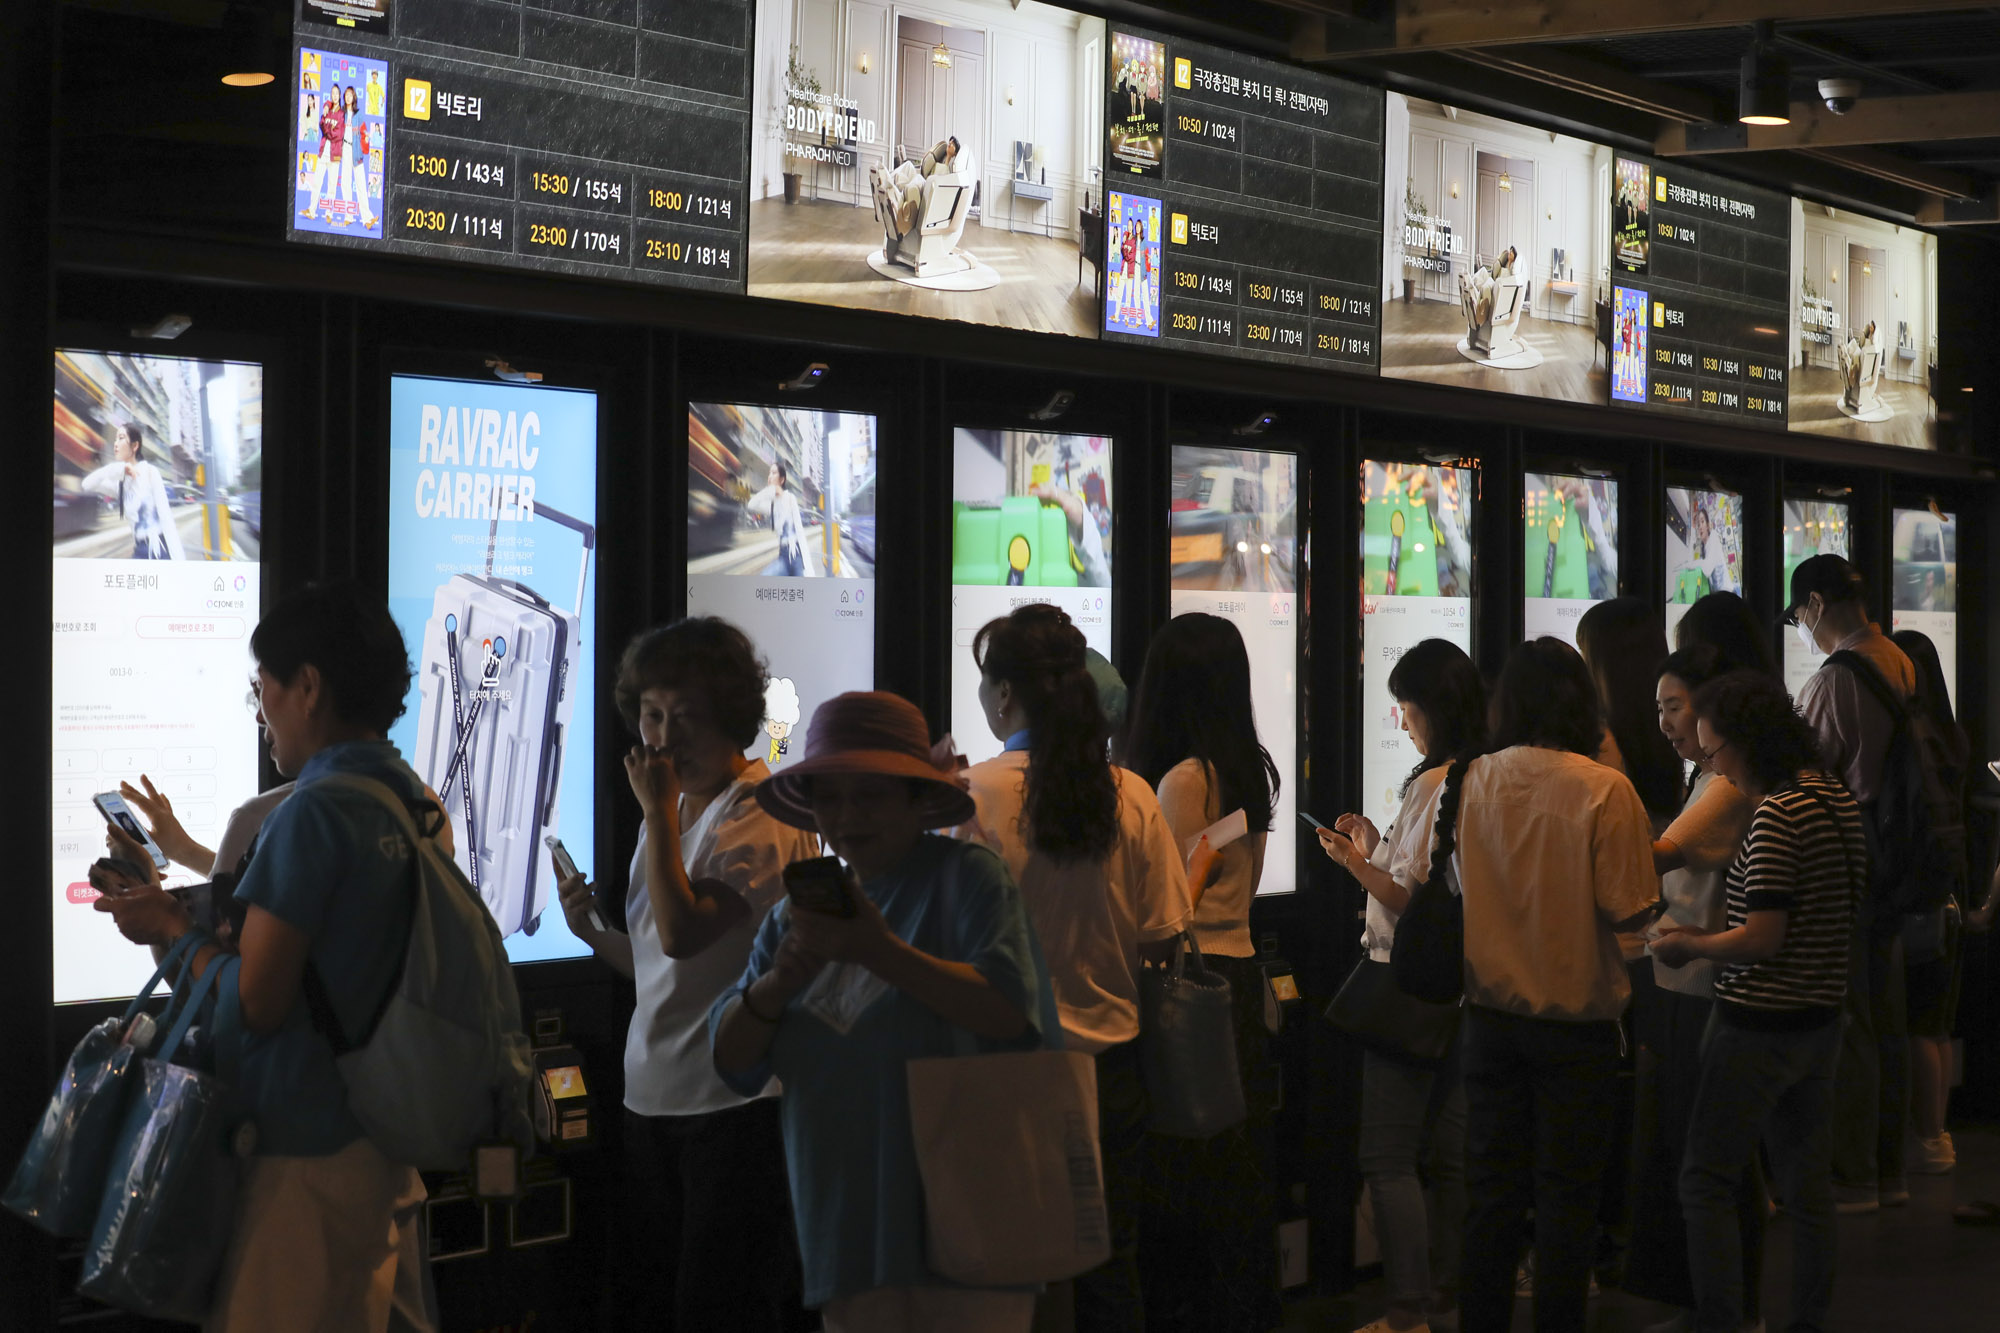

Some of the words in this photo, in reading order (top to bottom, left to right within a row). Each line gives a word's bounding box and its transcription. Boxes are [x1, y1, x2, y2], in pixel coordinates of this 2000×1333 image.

[787, 85, 832, 105] Healthcare
[833, 93, 858, 110] Robot
[1177, 65, 1188, 83] 12
[1194, 67, 1240, 96] 극장총집편
[1242, 79, 1260, 100] 봇치
[1263, 84, 1272, 103] 더
[1274, 87, 1287, 106] 록!
[1289, 91, 1329, 116] 전편(자막)
[409, 87, 426, 113] 12
[437, 91, 482, 121] 빅토리
[786, 104, 875, 144] BODYFRIEND
[1177, 115, 1201, 134] 10:50
[1203, 120, 1208, 137] /
[1211, 123, 1236, 143] 102석
[786, 143, 830, 163] PHARAOH
[832, 151, 851, 166] NEO
[409, 154, 447, 177] 13:00
[452, 159, 459, 180] /
[465, 162, 504, 187] 143석
[533, 172, 568, 194] 15:30
[572, 177, 580, 197] /
[585, 180, 622, 203] 155석
[1658, 181, 1665, 197] 12
[1668, 183, 1698, 206] 극장총집편
[1699, 191, 1711, 209] 봇치
[1712, 195, 1719, 211] 더
[319, 198, 360, 216] 빅토리
[648, 189, 682, 211] 18:00
[685, 194, 692, 213] /
[697, 197, 731, 219] 121석
[406, 208, 445, 231] 20:30
[450, 213, 458, 233] /
[463, 215, 502, 240] 111석
[1405, 209, 1434, 225] Healthcare
[1435, 215, 1451, 228] Robot
[530, 224, 567, 246] 23:00
[571, 229, 578, 249] /
[584, 231, 620, 254] 170석
[1174, 220, 1185, 239] 12
[1191, 223, 1219, 245] 빅토리
[1405, 225, 1463, 255] BODYFRIEND
[1657, 223, 1673, 238] 10:50
[1674, 227, 1678, 240] /
[1679, 228, 1695, 244] 102석
[646, 239, 681, 261] 25:10
[684, 244, 691, 263] /
[696, 247, 730, 269] 181석
[1404, 255, 1433, 270] PHARAOH
[1434, 261, 1447, 273] NEO
[1174, 271, 1197, 289] 13:00
[1200, 275, 1205, 291] /
[1208, 276, 1232, 296] 143석
[1249, 283, 1271, 301] 15:30
[1273, 287, 1278, 302] /
[1280, 288, 1303, 307] 155석
[1319, 295, 1340, 312] 18:00
[1342, 298, 1347, 313] /
[1349, 300, 1371, 317] 121석
[1173, 313, 1197, 330] 20:30
[1199, 317, 1204, 333] /
[1207, 318, 1231, 337] 111석
[1666, 308, 1684, 327] 빅토리
[1802, 306, 1840, 329] BODYFRIEND
[1247, 324, 1270, 341] 23:00
[1272, 327, 1277, 343] /
[1279, 329, 1302, 347] 170석
[1318, 335, 1339, 351] 25:10
[1341, 338, 1346, 353] /
[1348, 339, 1370, 357] 181석
[1655, 349, 1671, 363] 13:00
[1672, 352, 1676, 364] /
[1677, 352, 1693, 368] 143석
[1703, 357, 1718, 372] 15:30
[1718, 360, 1722, 372] /
[1723, 360, 1739, 375] 155석
[1748, 365, 1763, 378] 18:00
[1763, 367, 1767, 380] /
[1768, 367, 1783, 382] 121석
[1654, 383, 1670, 397] 20:30
[1671, 385, 1675, 398] /
[1676, 386, 1692, 401] 111석
[1702, 390, 1717, 404] 23:00
[1718, 392, 1722, 405] /
[1723, 393, 1738, 408] 170석
[1747, 397, 1762, 410] 25:10
[1762, 399, 1766, 411] /
[1767, 400, 1782, 414] 181석
[418, 404, 540, 471] RAVRAC
[415, 468, 536, 522] CARRIER
[104, 574, 159, 590] 포토플레이
[755, 587, 804, 602] 예매티켓출력
[1218, 601, 1246, 613] 포토플레이
[202, 623, 215, 632] 조회
[450, 657, 459, 691] RAVRAC
[469, 690, 490, 702] 터치해
[491, 690, 512, 702] 주세요
[457, 724, 471, 755] RAVRAC
[128, 757, 132, 765] 2
[187, 755, 192, 764] 3
[67, 787, 71, 795] 4
[187, 784, 192, 792] 6
[67, 816, 71, 824] 7
[187, 811, 191, 819] 9
